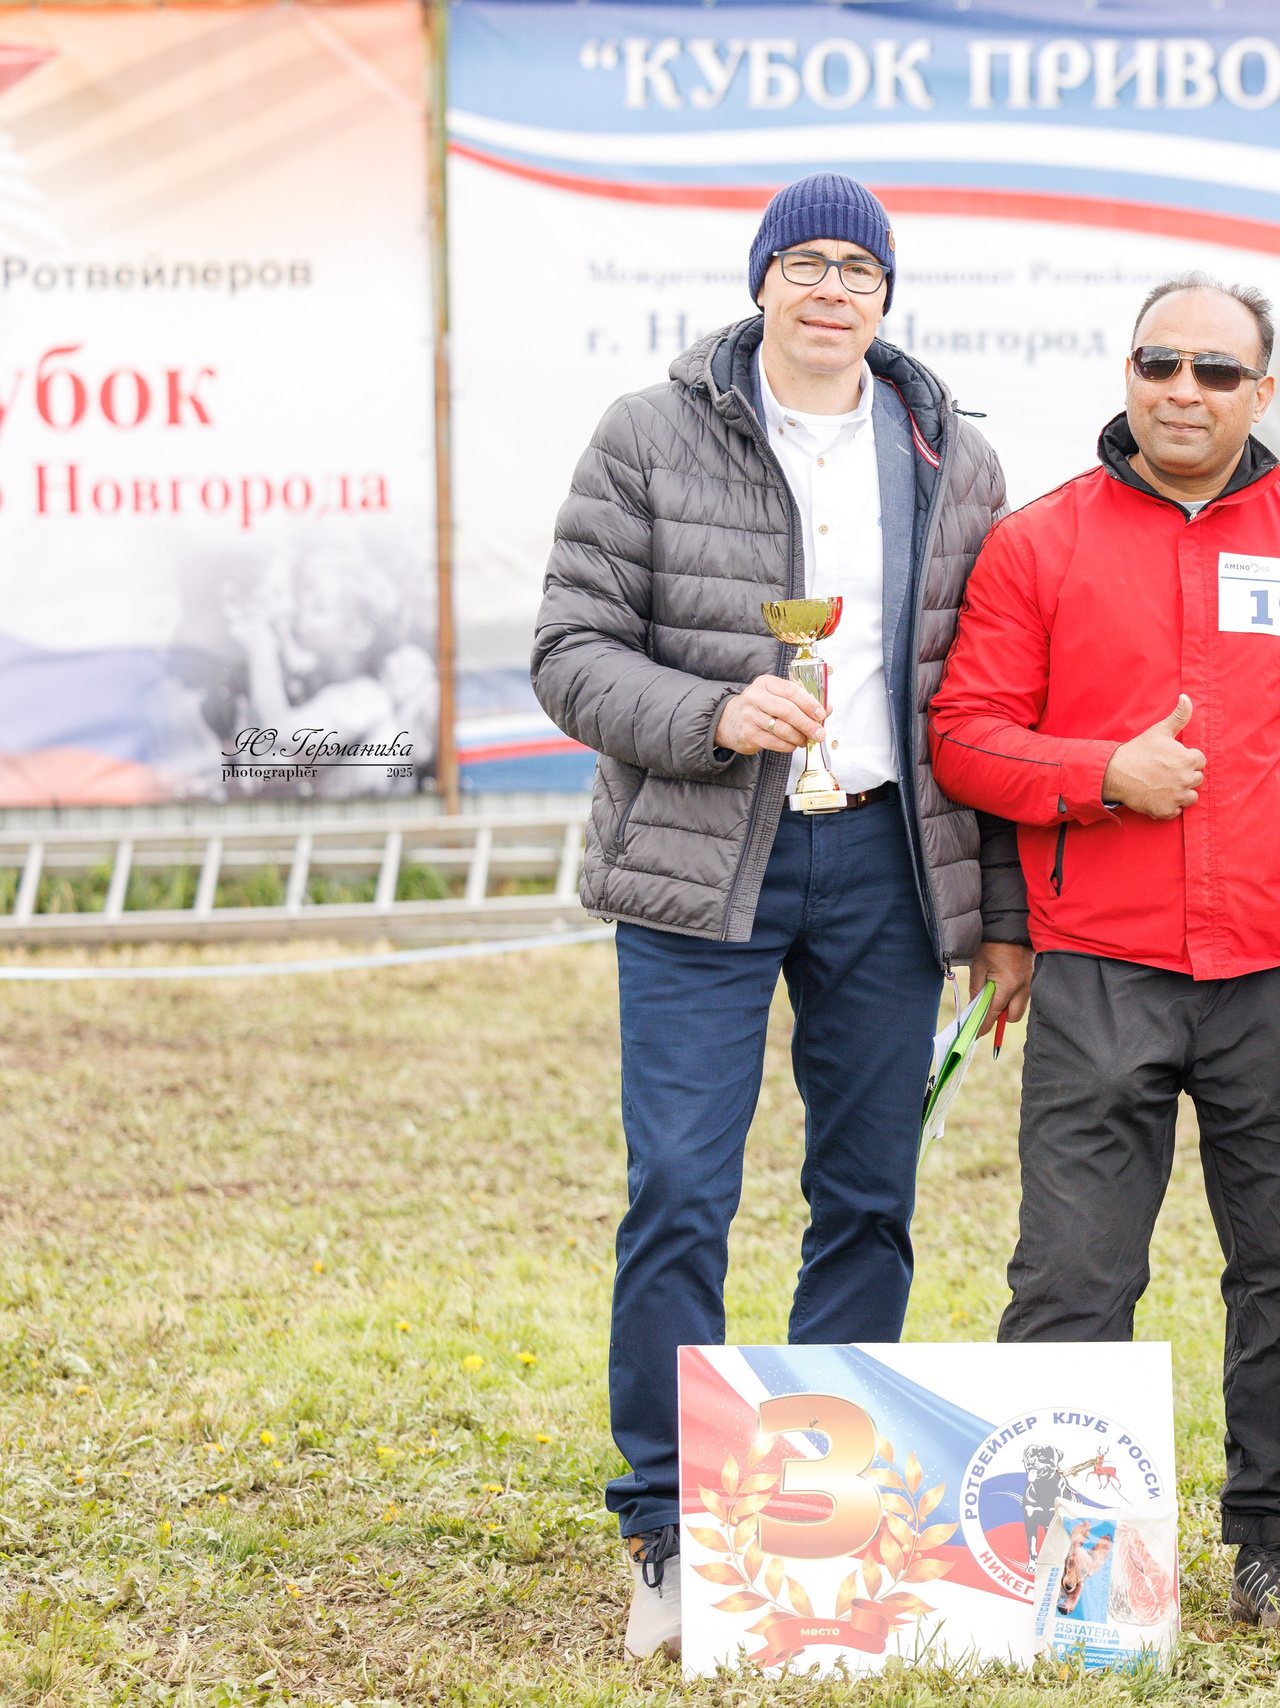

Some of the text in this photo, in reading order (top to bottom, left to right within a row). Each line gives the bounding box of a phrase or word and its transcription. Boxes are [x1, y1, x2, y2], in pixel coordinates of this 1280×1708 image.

[2, 255, 313, 295] Ротвейлеров
[34, 464, 390, 530] Новгорода
[756, 1392, 883, 1560] 3
[964, 1416, 1038, 1520] РОТВЕЙЛЕР
[1053, 1412, 1109, 1434] КЛУБ
[800, 1626, 840, 1638] место
[1064, 1623, 1120, 1639] STATERA
